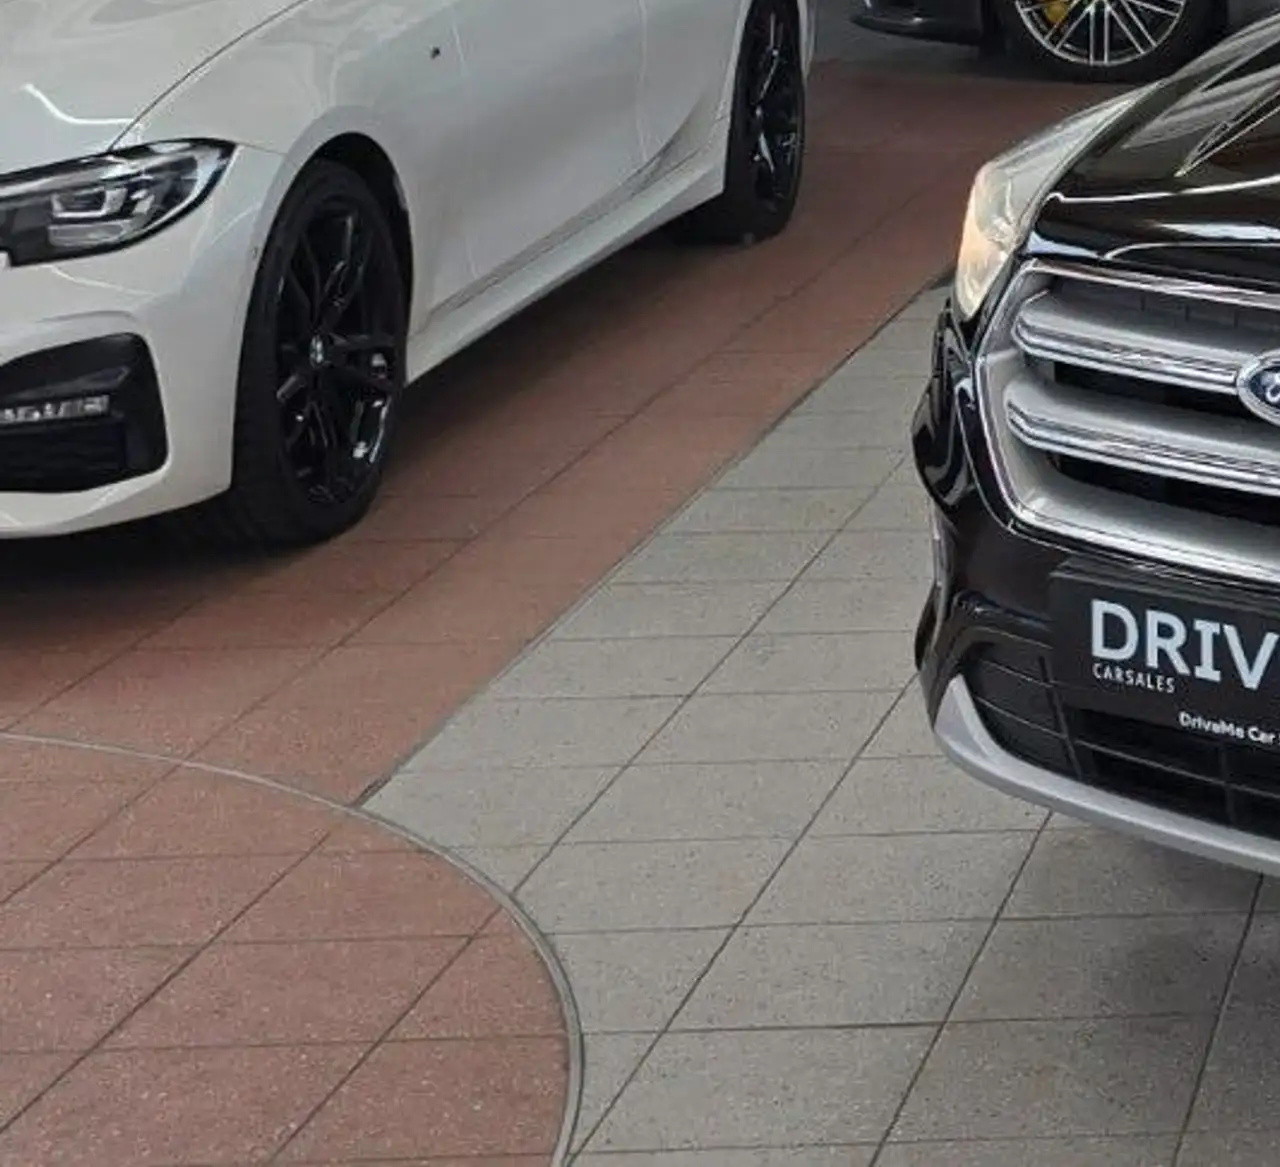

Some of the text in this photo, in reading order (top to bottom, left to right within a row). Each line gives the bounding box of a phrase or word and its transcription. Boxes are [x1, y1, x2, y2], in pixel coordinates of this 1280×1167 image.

[1092, 663, 1175, 693] CARSALES
[1178, 711, 1244, 739] DriveMe
[1249, 726, 1276, 745] Car
